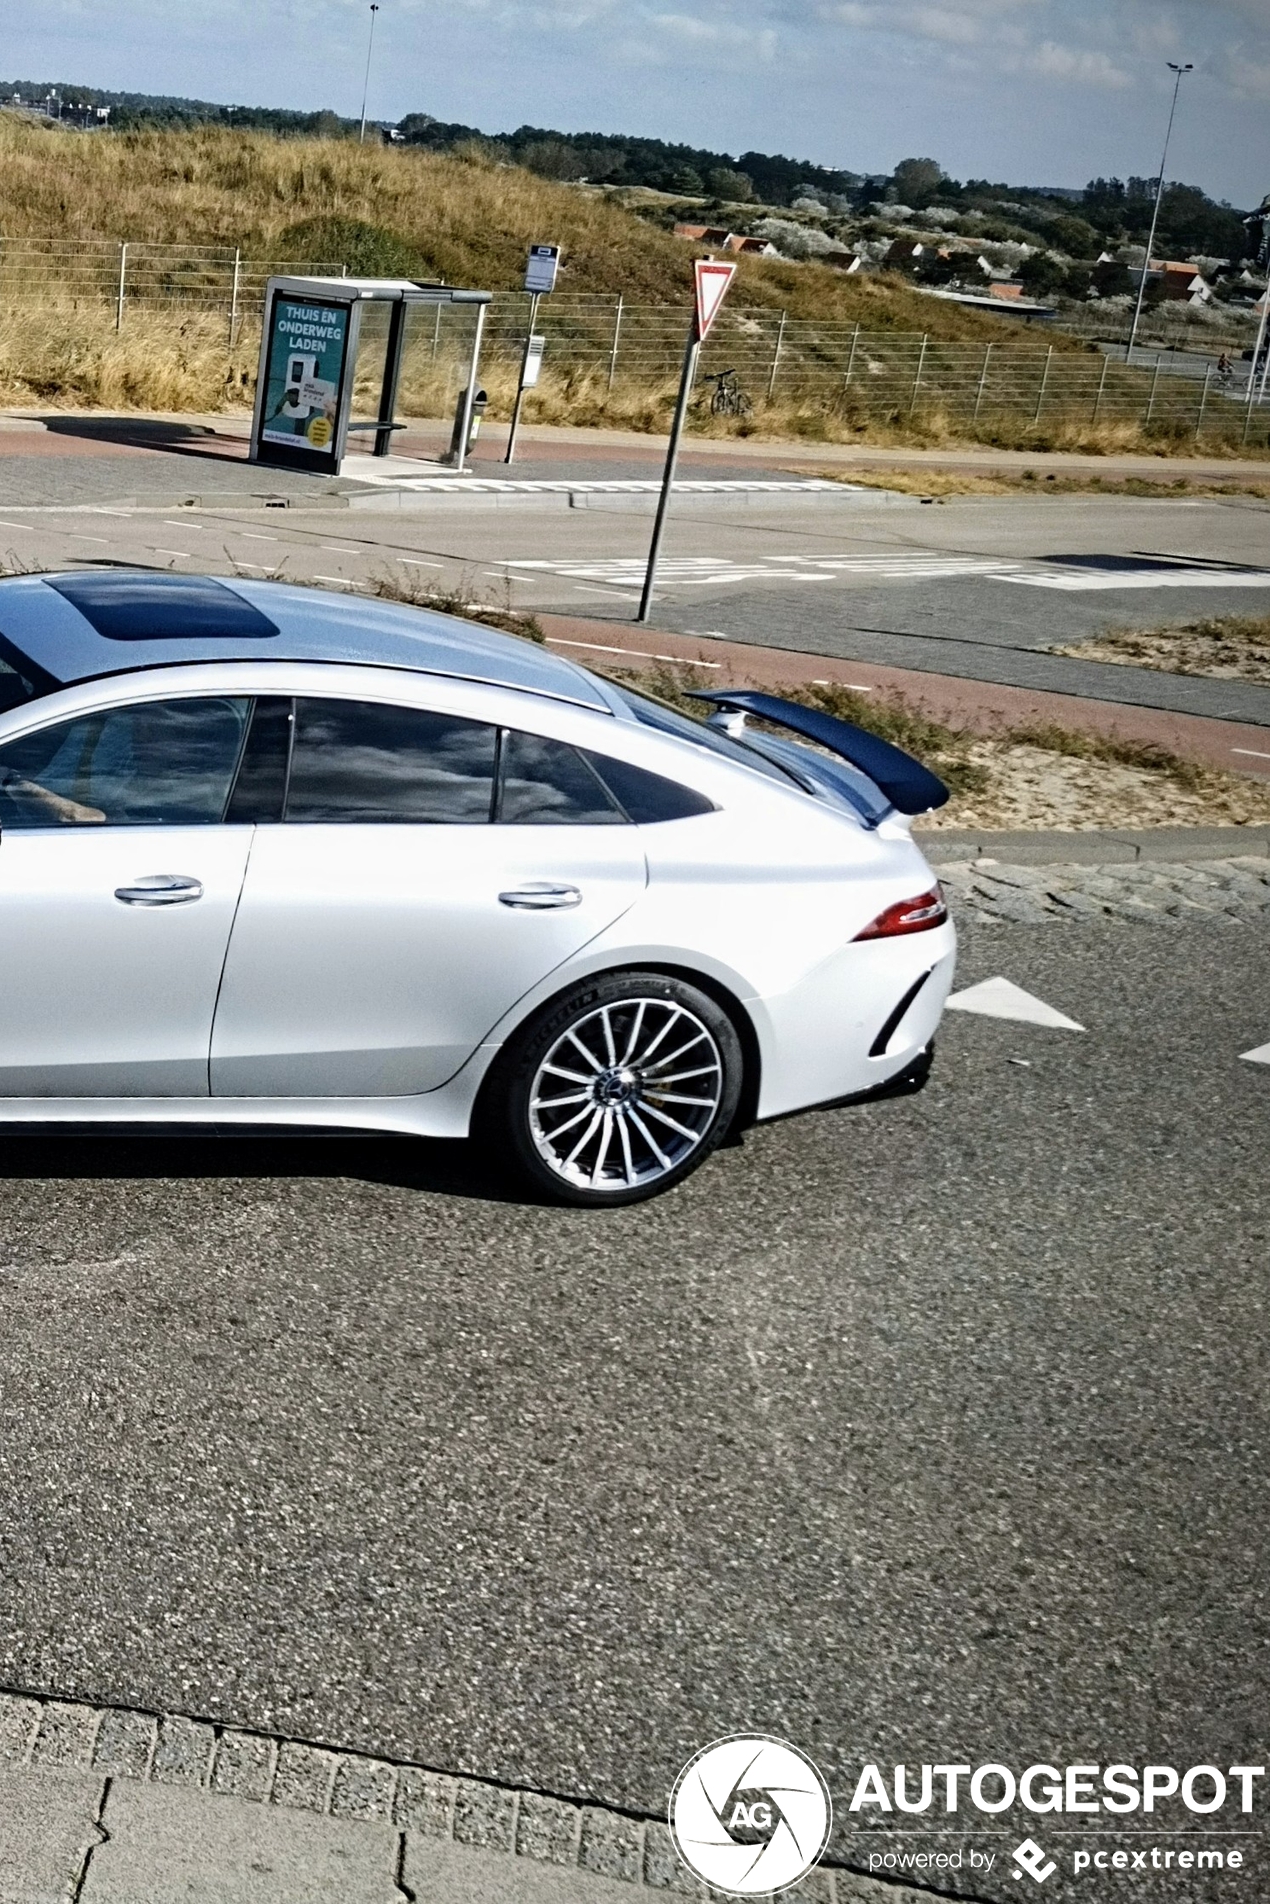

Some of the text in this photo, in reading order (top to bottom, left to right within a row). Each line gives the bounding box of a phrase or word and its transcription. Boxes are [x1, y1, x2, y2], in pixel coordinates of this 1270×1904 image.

[286, 306, 320, 322] THUIS
[278, 320, 342, 340] ONDERWEG
[289, 336, 327, 353] LADEN
